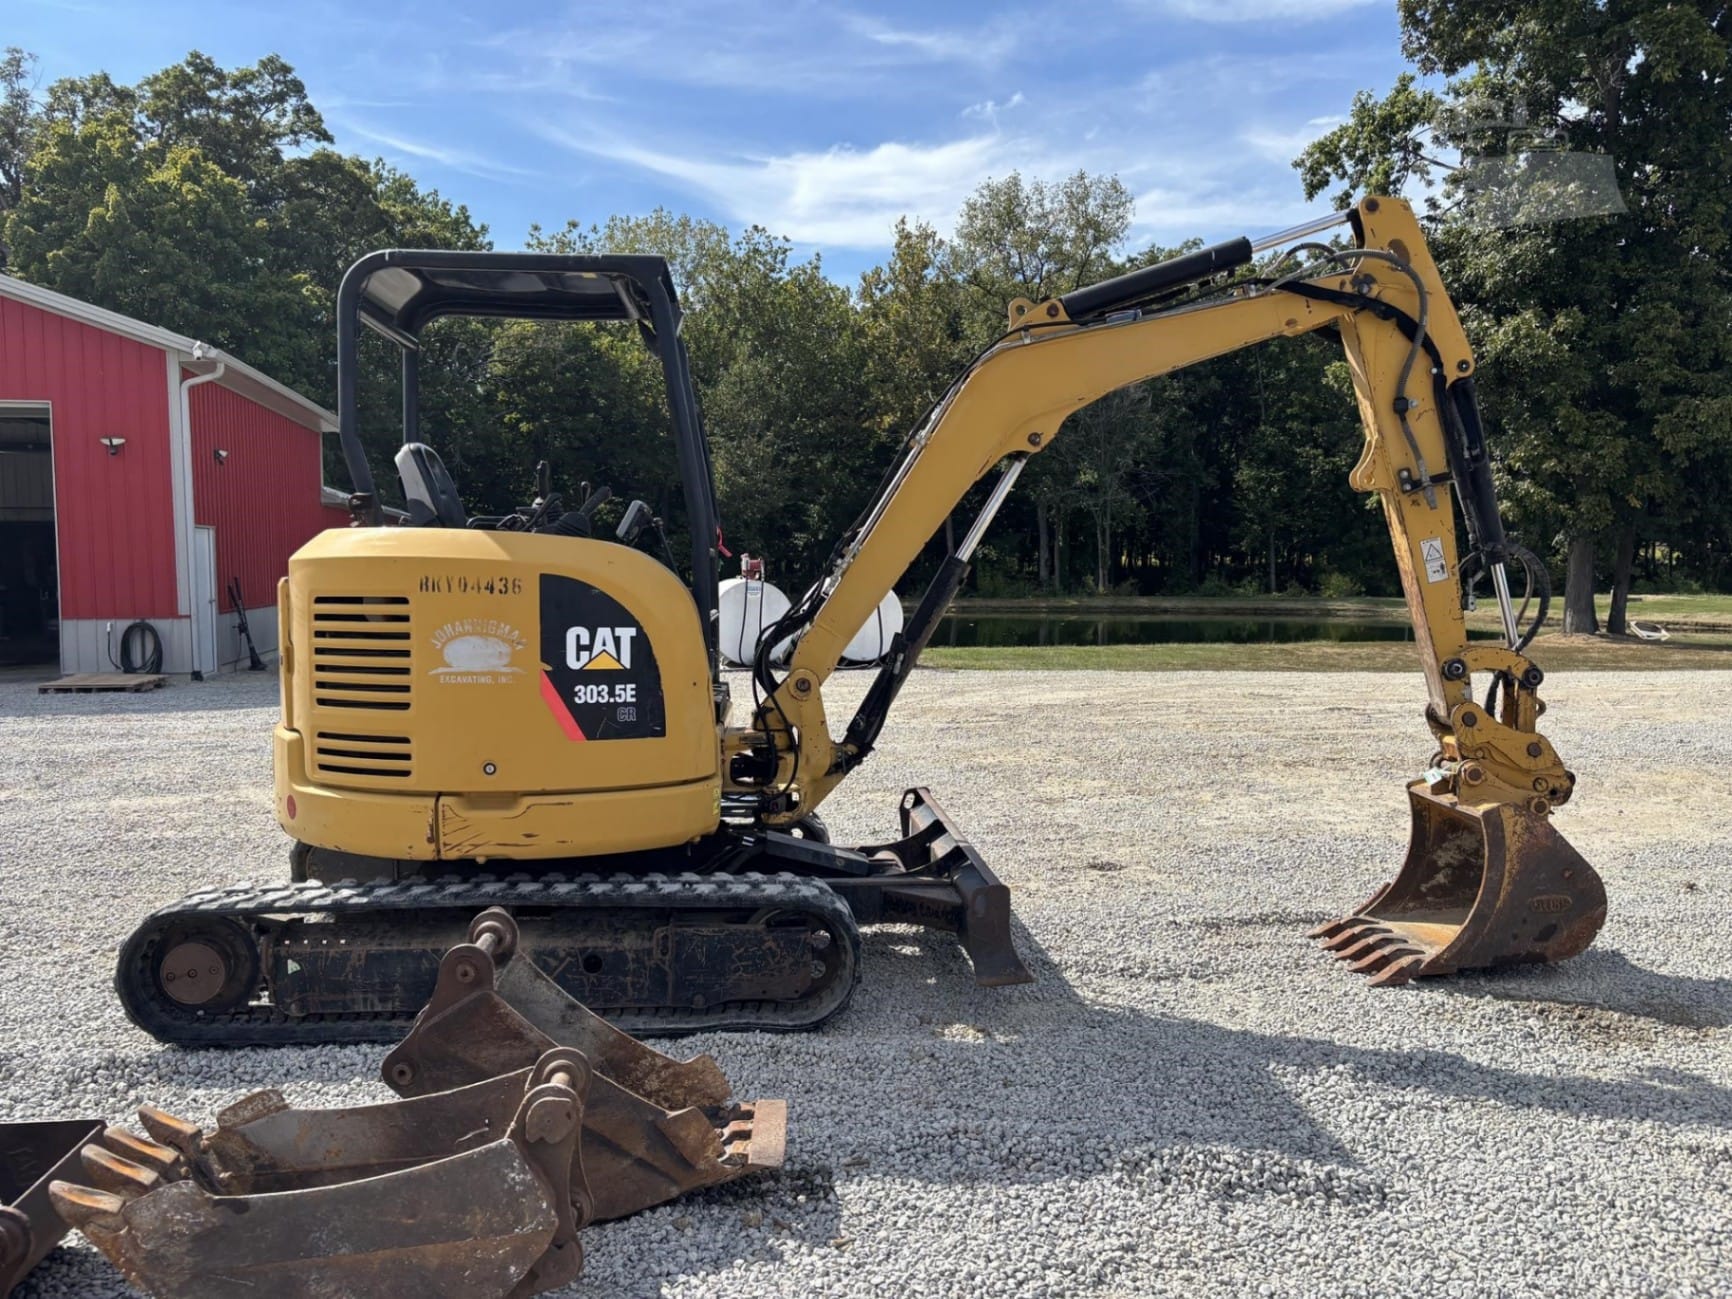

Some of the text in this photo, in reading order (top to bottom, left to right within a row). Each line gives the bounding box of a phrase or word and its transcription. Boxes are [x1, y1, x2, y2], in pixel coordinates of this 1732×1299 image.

[566, 626, 637, 670] CAT
[574, 683, 637, 704] 303.5E
[617, 706, 637, 721] CR
